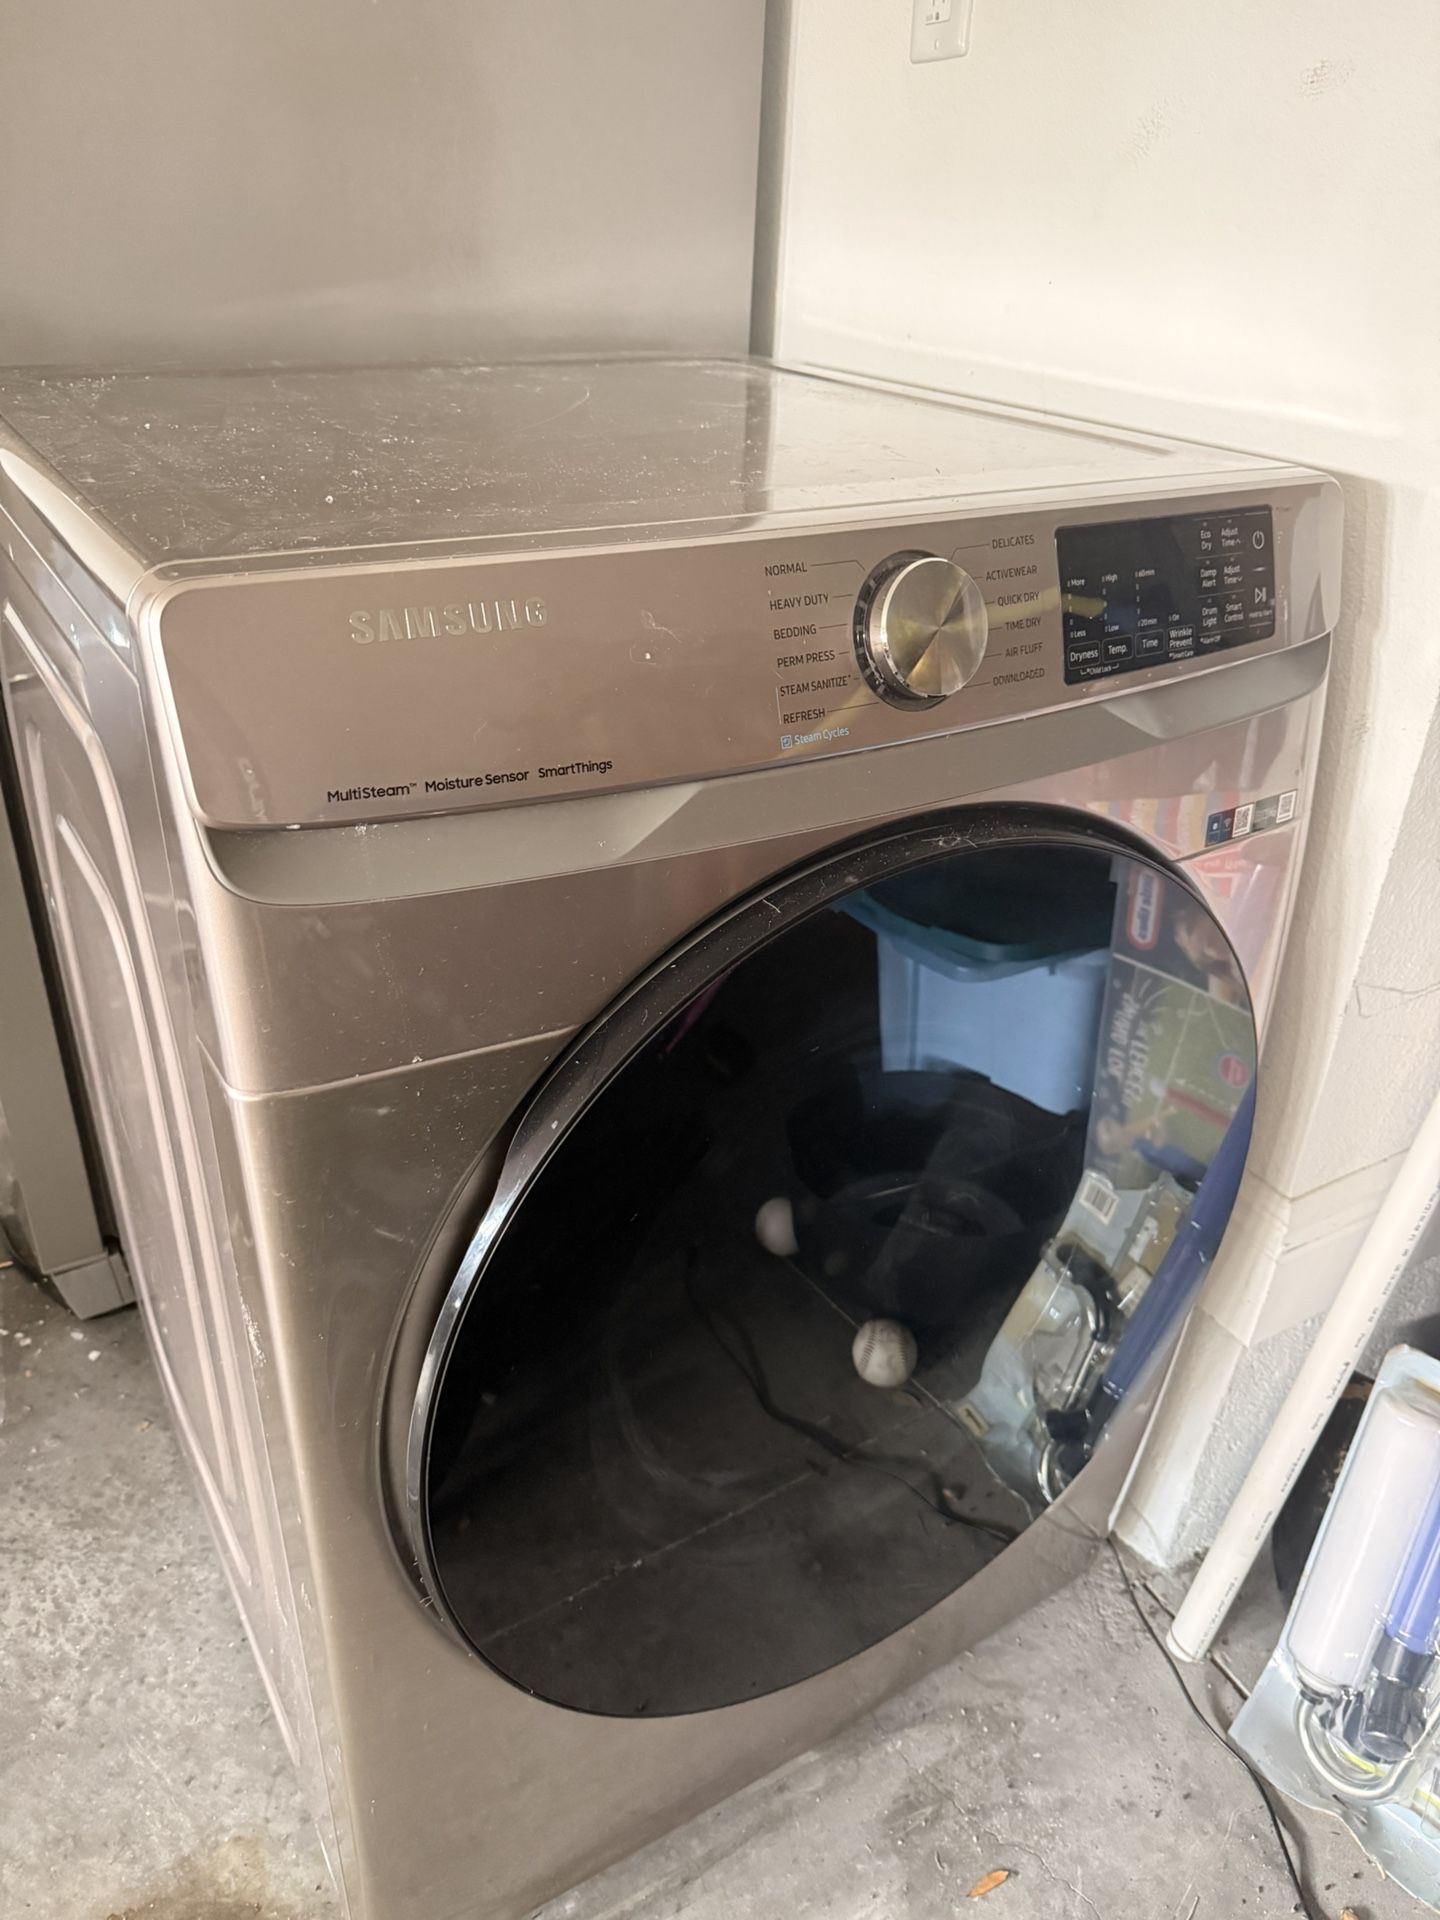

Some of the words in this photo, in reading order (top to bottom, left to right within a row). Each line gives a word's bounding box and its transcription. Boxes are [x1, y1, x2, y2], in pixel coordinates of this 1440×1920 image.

[1200, 530, 1211, 539] Eco
[1221, 527, 1238, 537] Adjust
[992, 534, 1035, 549] DELICATES
[1201, 541, 1212, 551] Dry
[764, 562, 807, 577] NORMAL
[986, 564, 1038, 581] ACTIVEWEAR
[1223, 565, 1241, 575] Adjust
[1071, 579, 1085, 587] More
[1106, 574, 1118, 583] High
[1202, 579, 1216, 588] Alert
[769, 597, 801, 611] HEAVY
[804, 593, 828, 606] DUTY
[997, 594, 1021, 606] QUICK
[1023, 592, 1039, 602] DRY
[1202, 607, 1218, 616] Drum
[1226, 602, 1242, 612] Smart
[349, 597, 548, 645] SAMSUNG
[1005, 619, 1025, 630] TIME
[1026, 617, 1041, 628] DRY
[1202, 617, 1217, 627] Light
[1224, 612, 1244, 623] Control
[773, 624, 817, 640] BEDDING
[1169, 627, 1193, 638] Wrinkle
[1005, 647, 1018, 657] AIR
[1020, 641, 1043, 655] FLUFF
[1142, 639, 1158, 648] Time
[1169, 637, 1193, 648] Prevent
[1070, 649, 1098, 662] Dryness
[1108, 644, 1128, 655] Temp.
[777, 654, 804, 668] PERM
[806, 650, 835, 663] PRESS
[993, 667, 1045, 686] DOWNLOADED
[780, 683, 809, 696] STEAM
[783, 708, 825, 724] REFRESH
[794, 732, 821, 744] Steam
[822, 727, 849, 740] Cycles
[538, 760, 613, 778] SmartThings
[425, 776, 483, 793] Moisture
[485, 771, 530, 785] Sensor
